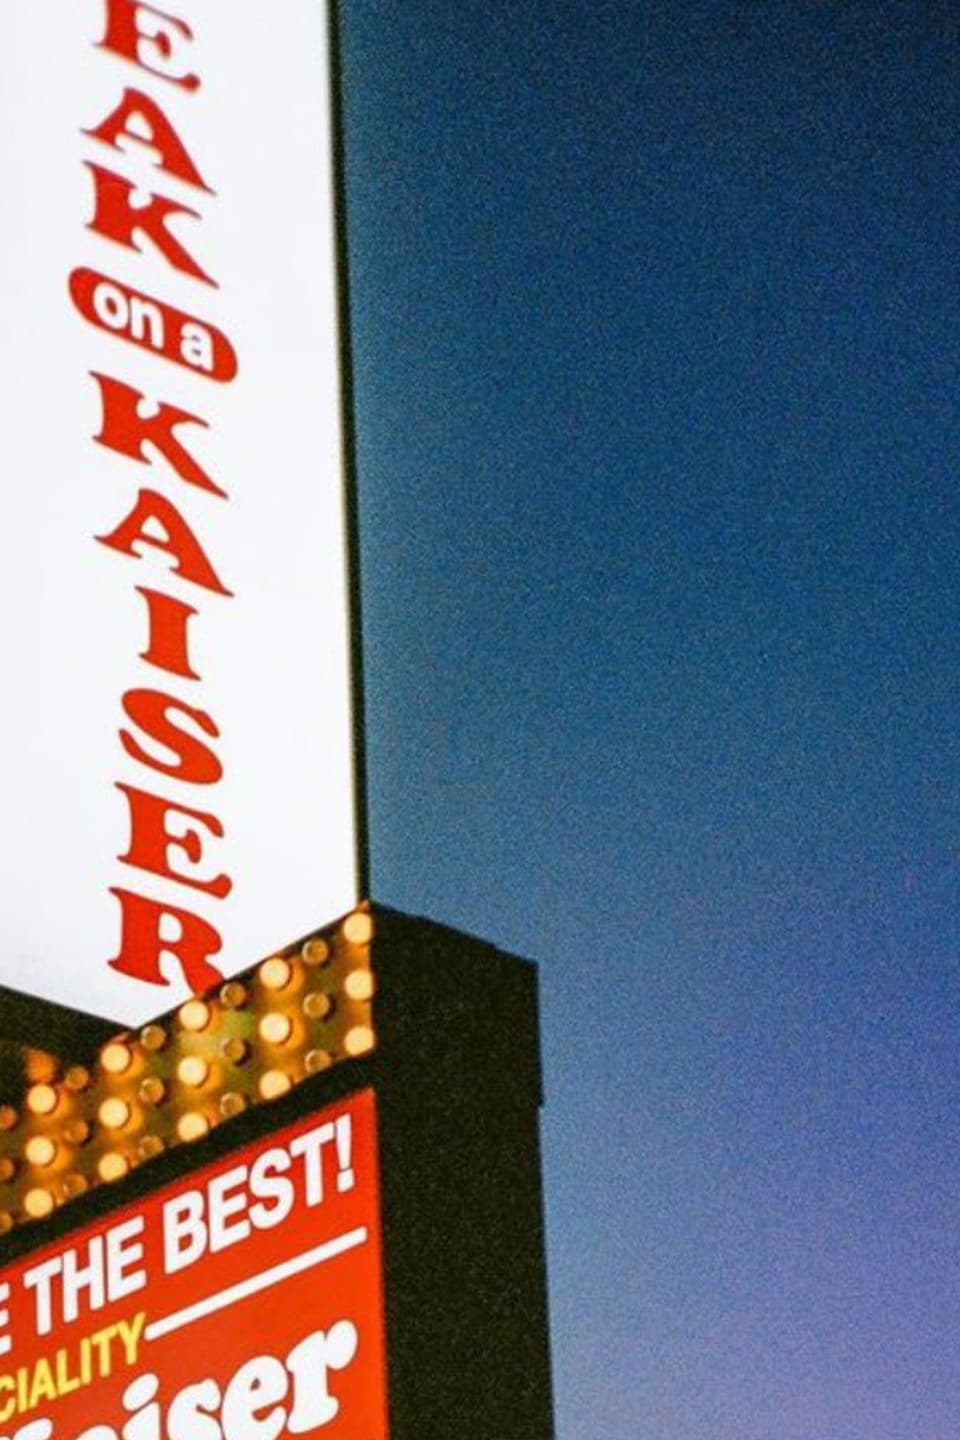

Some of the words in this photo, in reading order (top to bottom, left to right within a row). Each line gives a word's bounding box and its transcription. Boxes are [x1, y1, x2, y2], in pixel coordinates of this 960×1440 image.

[92, 282, 165, 349] on
[179, 323, 215, 371] a
[88, 370, 235, 1000] KAISER
[23, 1216, 147, 1336] THE
[162, 1113, 355, 1274] BEST!
